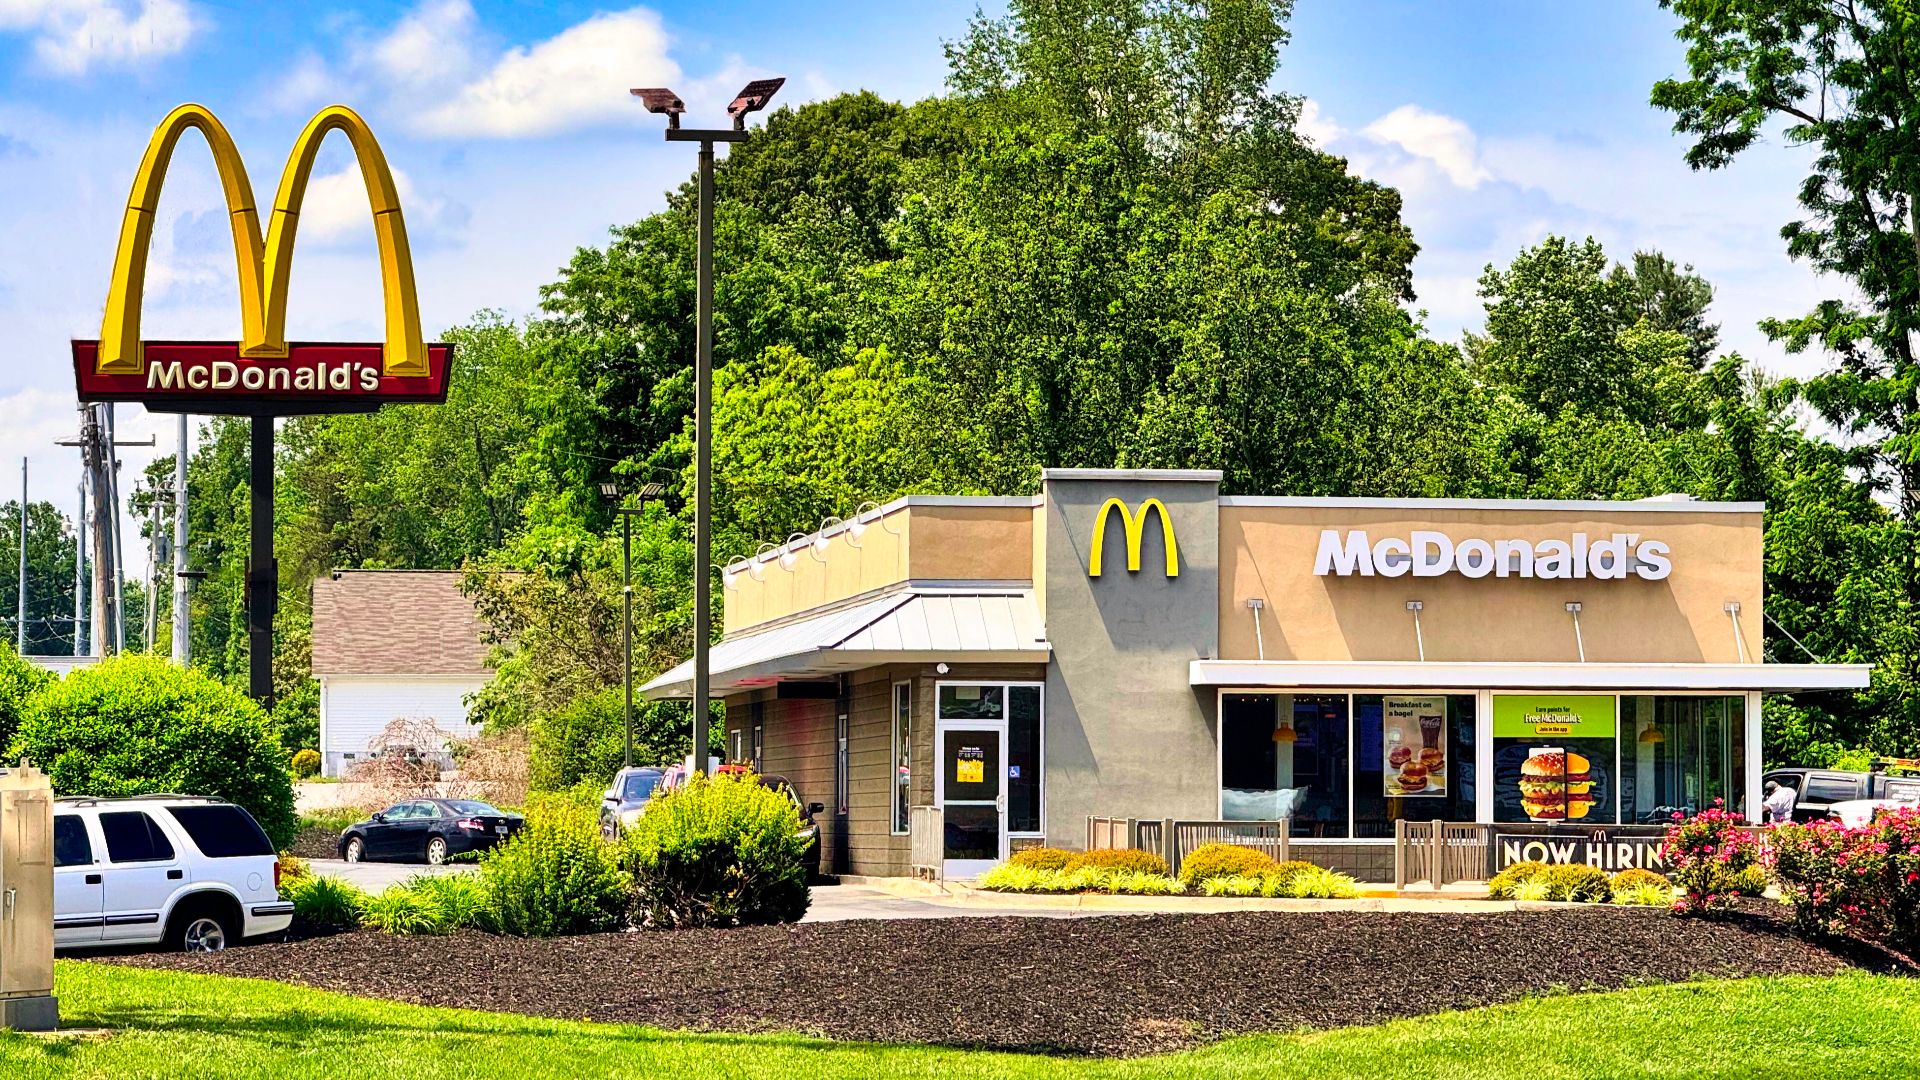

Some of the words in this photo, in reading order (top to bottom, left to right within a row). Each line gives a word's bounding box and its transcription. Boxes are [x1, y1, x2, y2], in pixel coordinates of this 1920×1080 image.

[147, 361, 379, 391] McDonald's
[1313, 529, 1672, 580] McDonald's
[1525, 714, 1541, 723] Free
[1541, 714, 1582, 723] McDonald's
[1504, 841, 1575, 864] NOW
[1587, 842, 1663, 869] HIRIN
